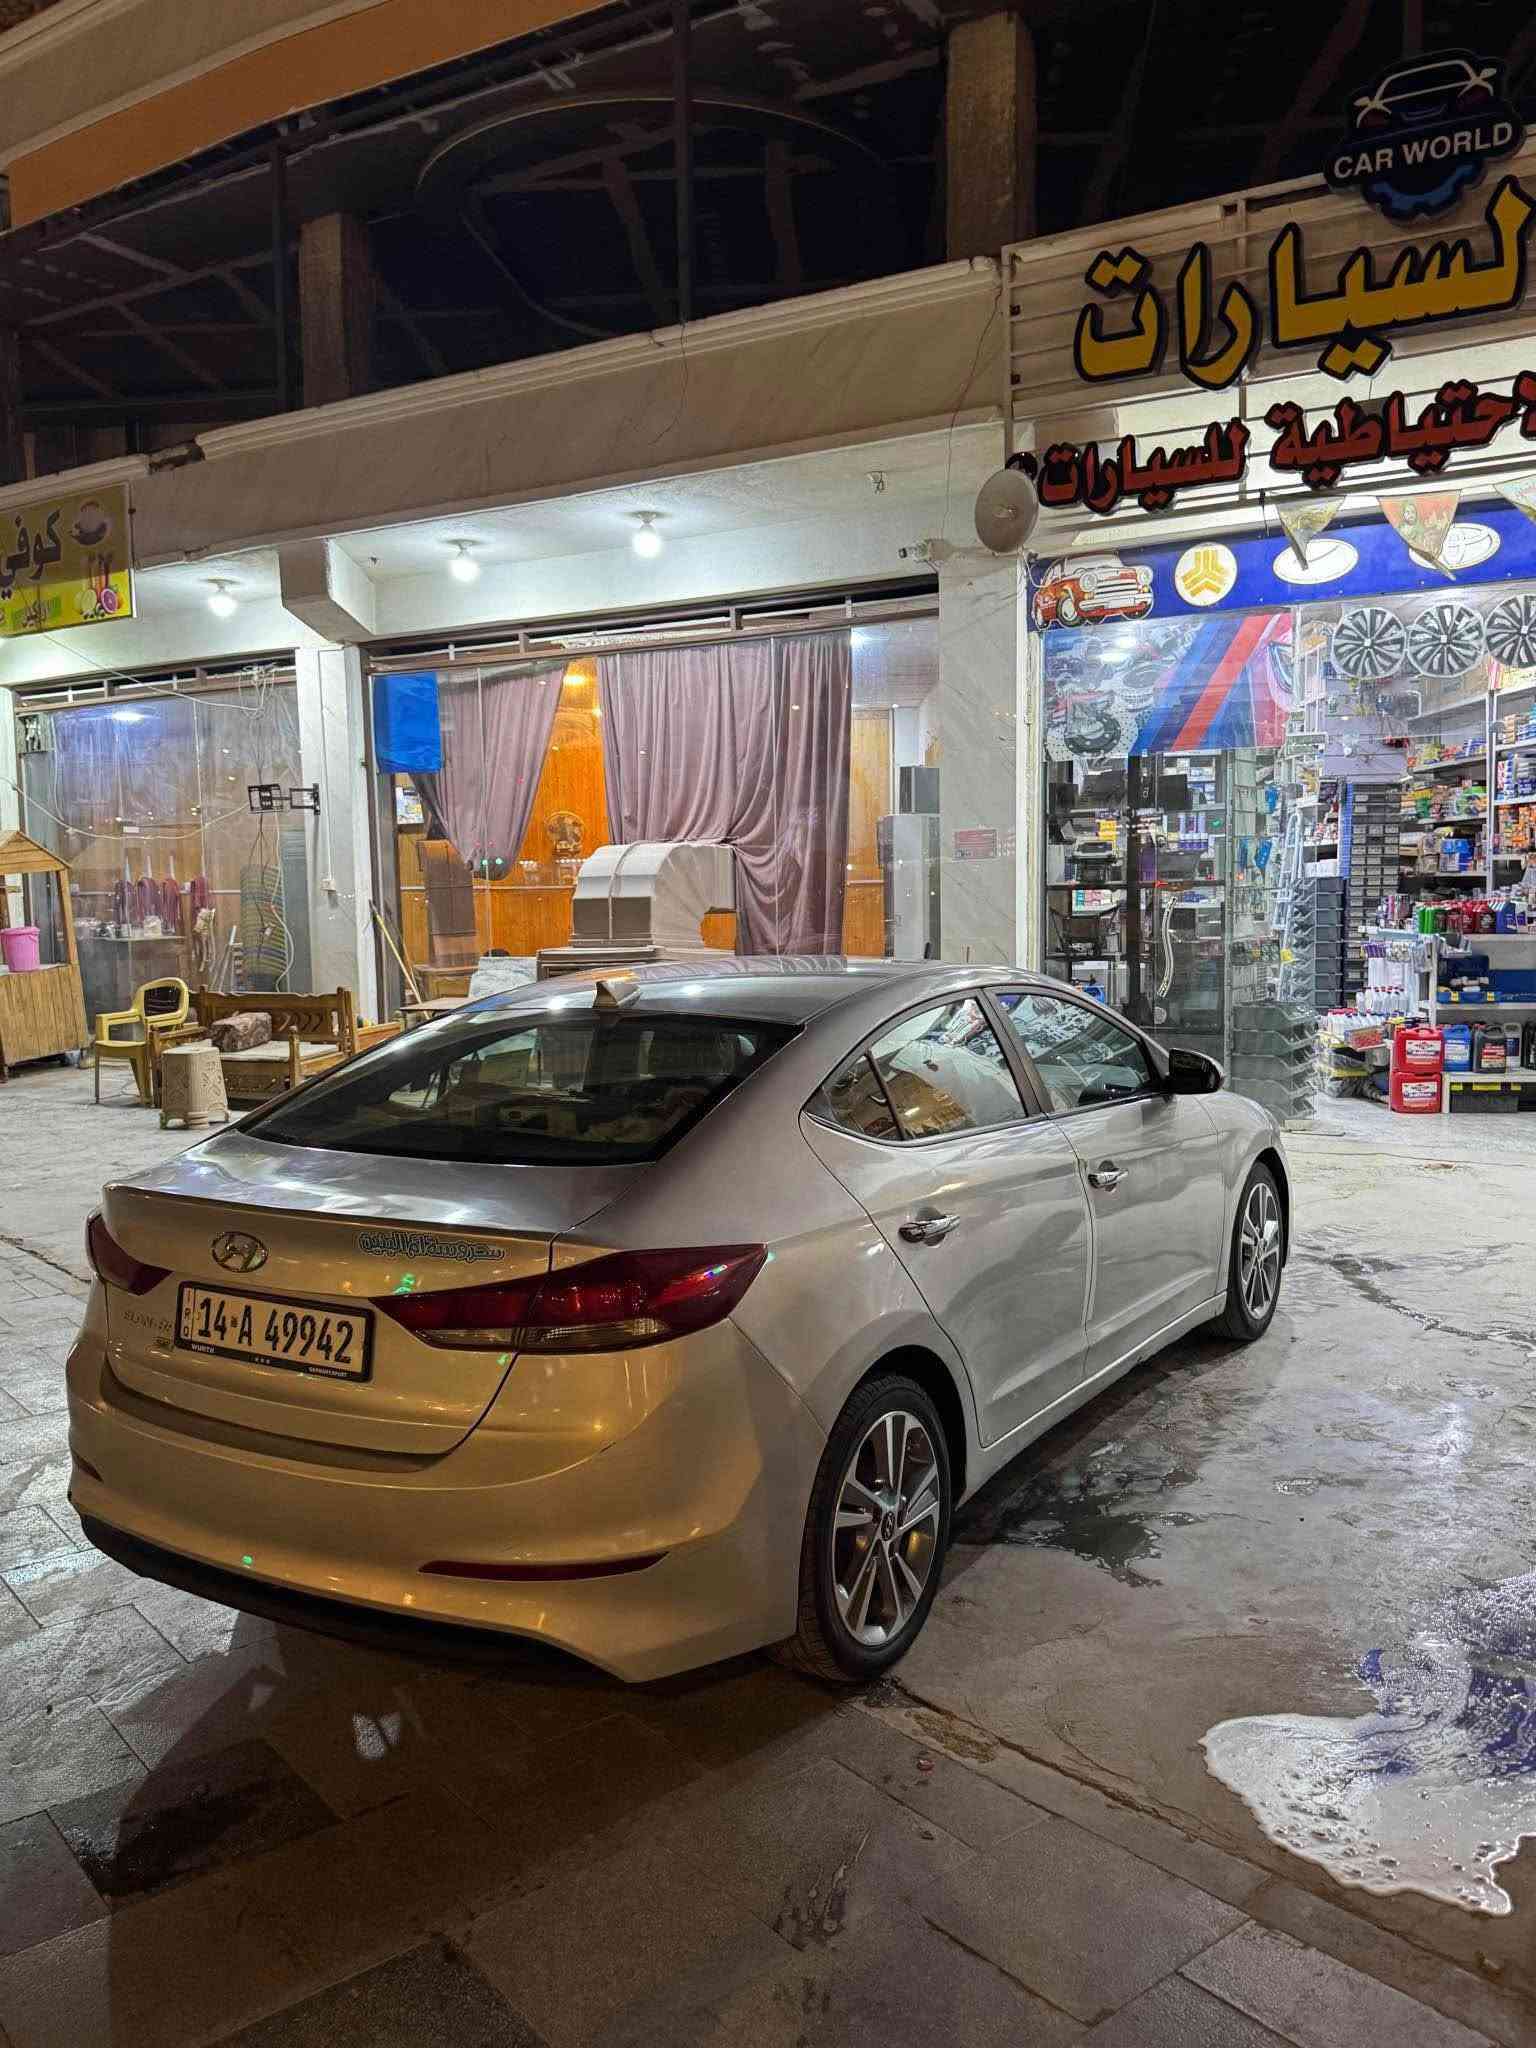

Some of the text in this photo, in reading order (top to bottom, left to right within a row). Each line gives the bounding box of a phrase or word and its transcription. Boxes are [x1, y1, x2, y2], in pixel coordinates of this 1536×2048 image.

[1334, 122, 1513, 178] CAR WORLD
[1037, 417, 1251, 515] للسيارات
[199, 1297, 227, 1340] 14
[238, 1305, 252, 1346] A
[265, 1309, 354, 1364] 49942
